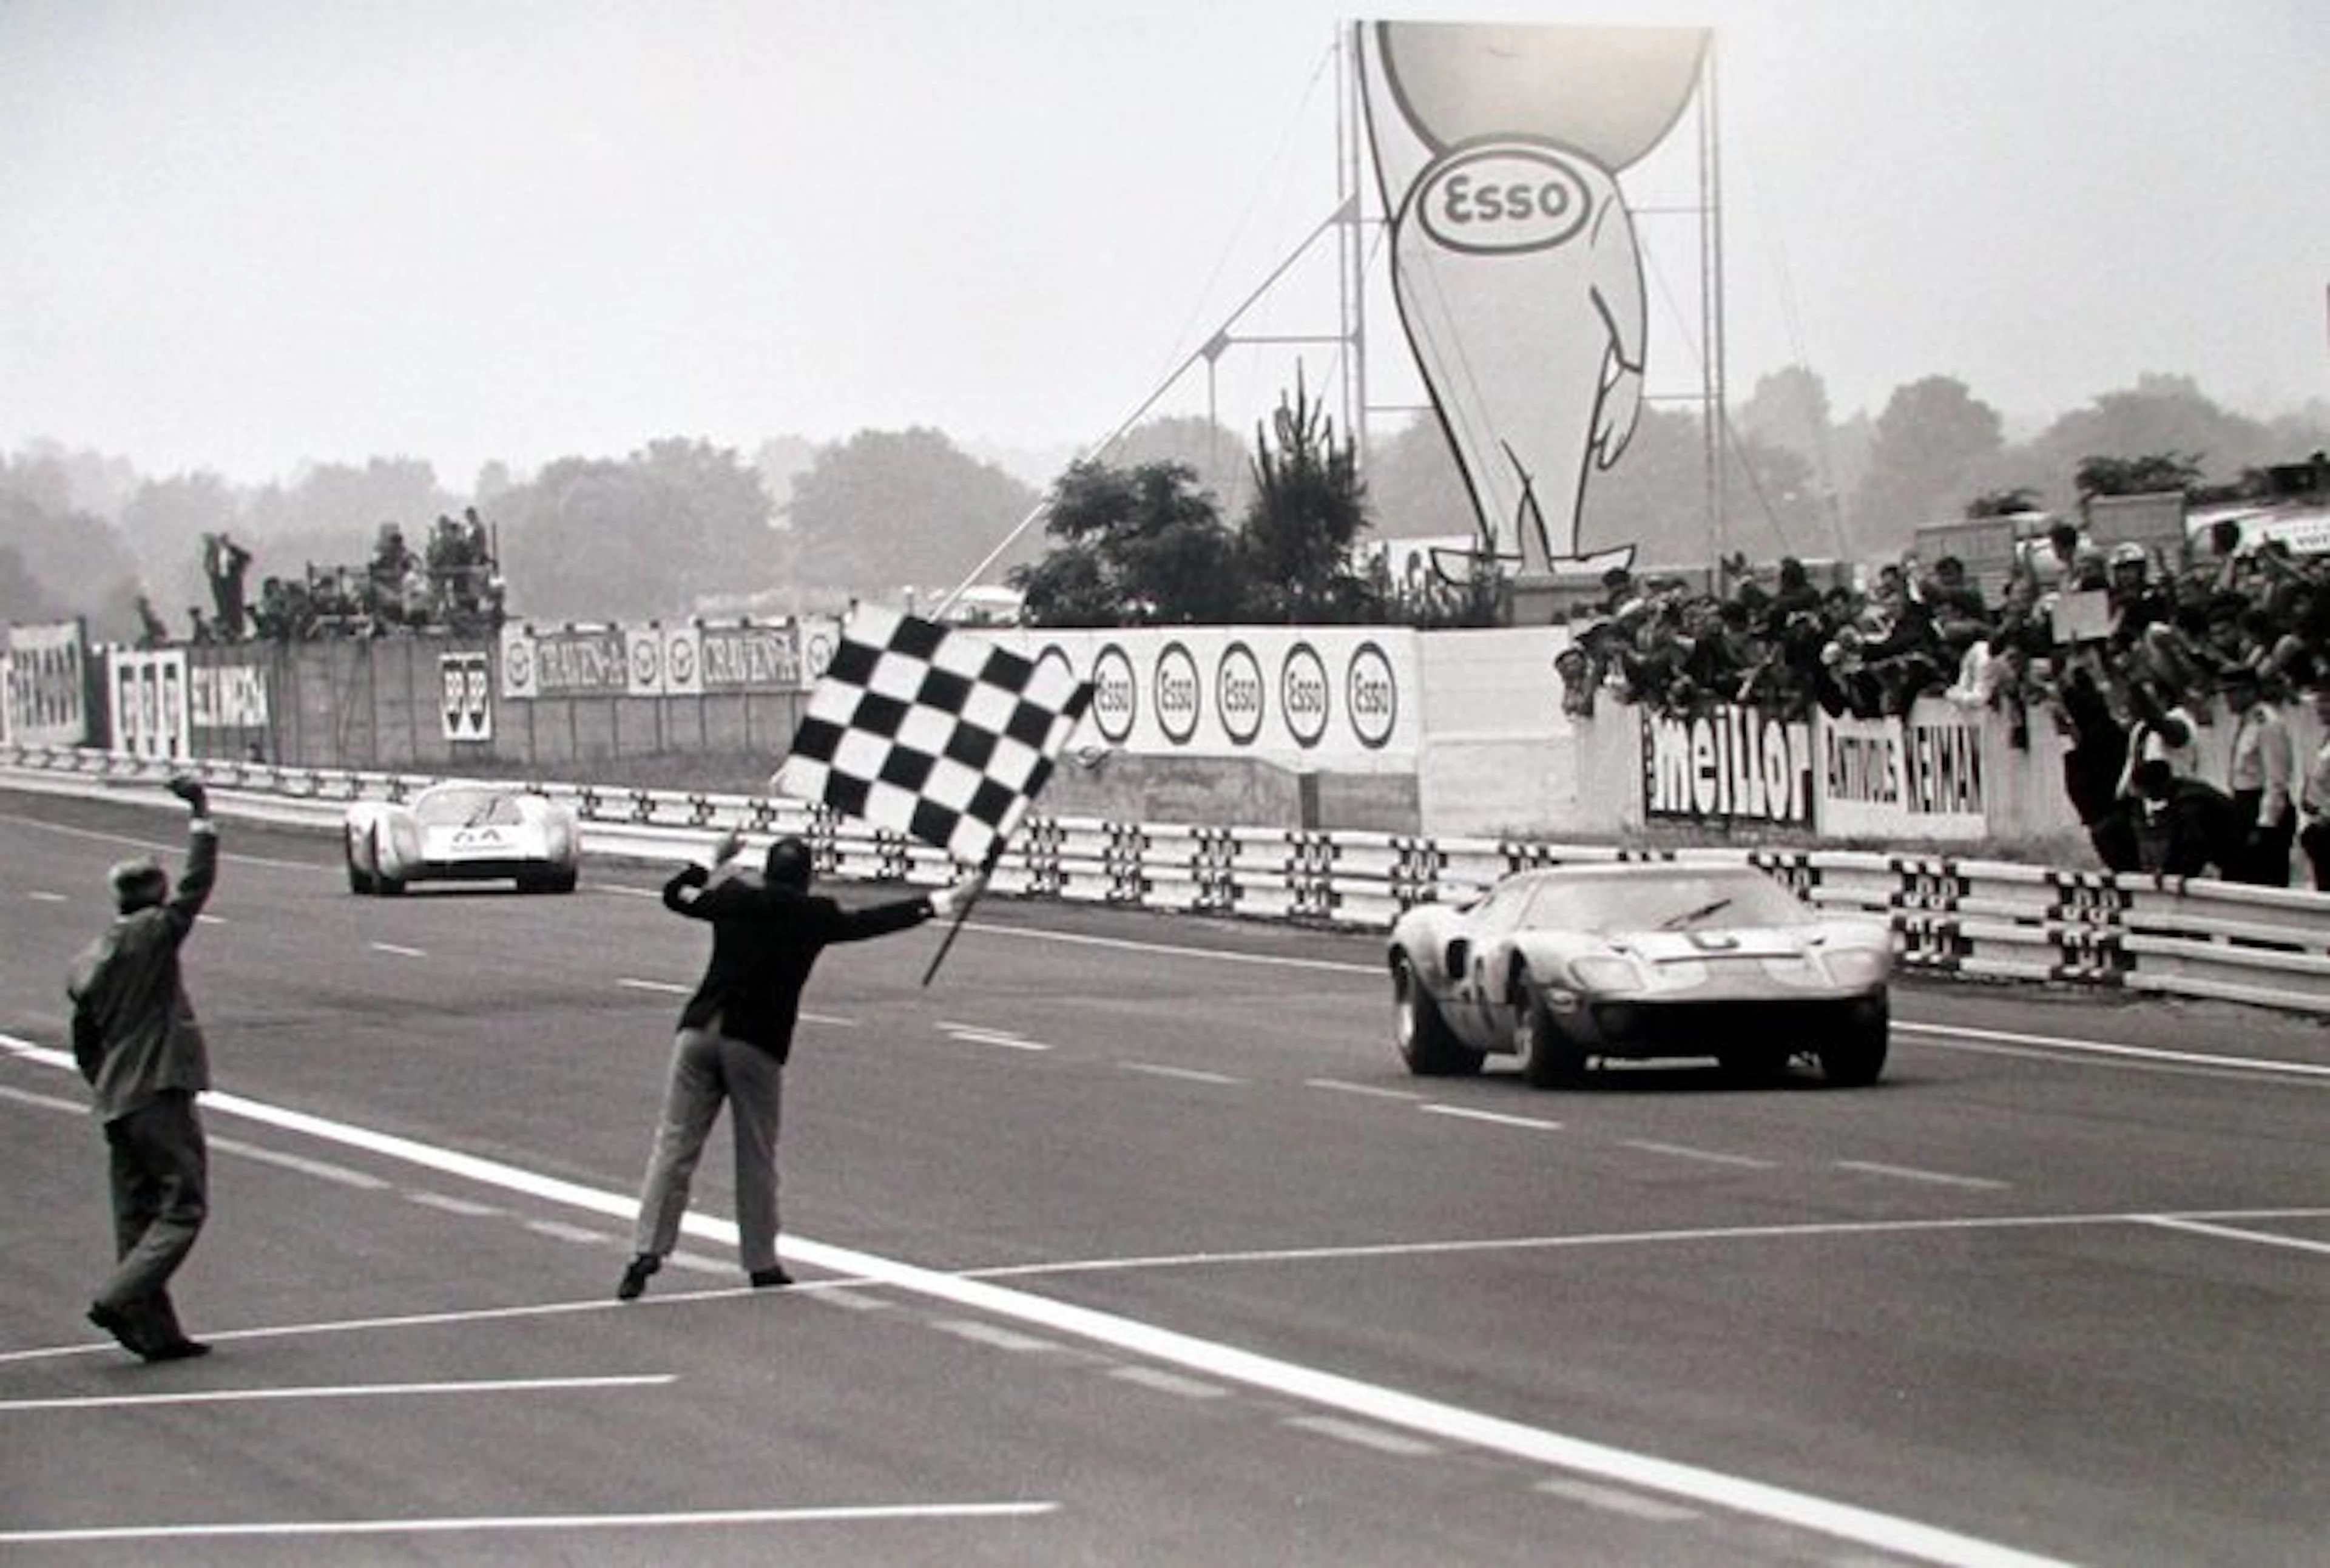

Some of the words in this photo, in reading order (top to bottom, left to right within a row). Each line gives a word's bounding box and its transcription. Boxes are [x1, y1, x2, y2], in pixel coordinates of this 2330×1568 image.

[1445, 174, 1569, 223] Esso
[1098, 671, 1129, 712] Esso
[1161, 671, 1193, 712] Esso
[1224, 669, 1257, 714] Esso
[1287, 669, 1323, 714] Esso
[1355, 669, 1390, 715] Esso
